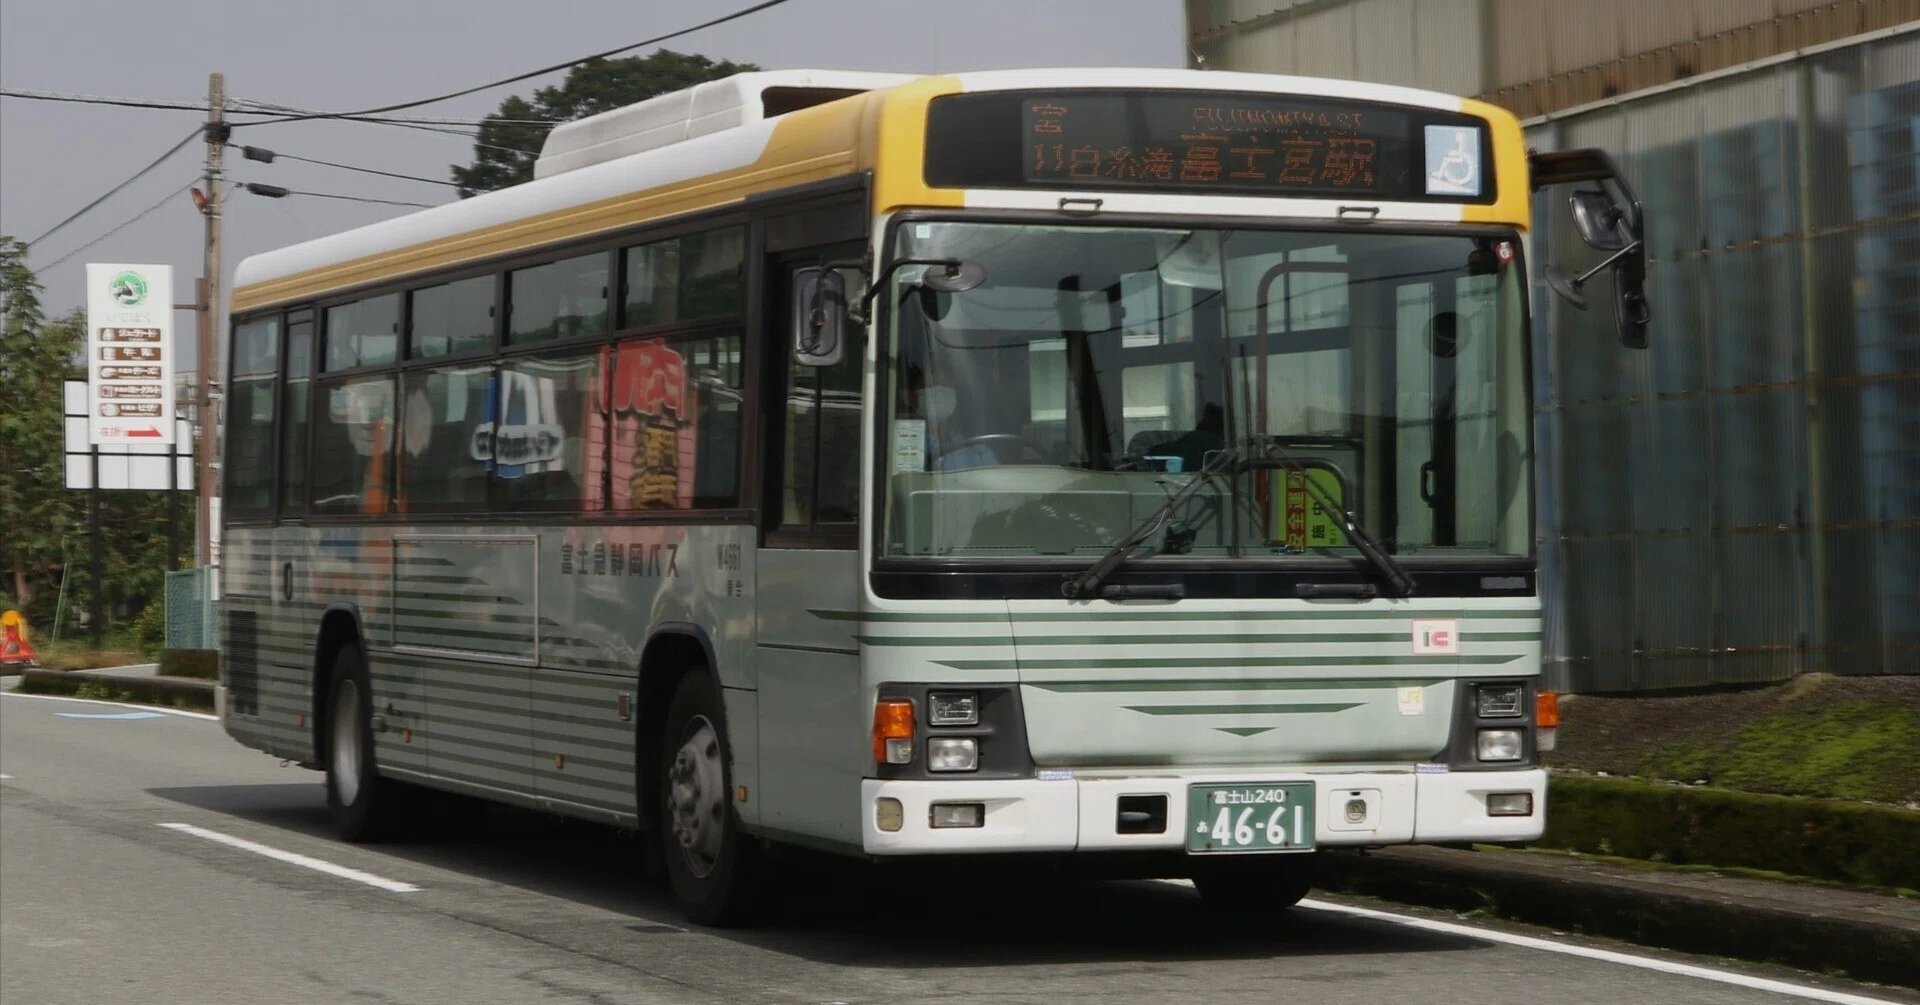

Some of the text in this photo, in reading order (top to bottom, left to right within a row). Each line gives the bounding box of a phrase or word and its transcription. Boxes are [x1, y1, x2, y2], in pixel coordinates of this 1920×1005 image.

[561, 542, 679, 578] 富士急静岡バス
[1196, 805, 1304, 846] あ 46-61
